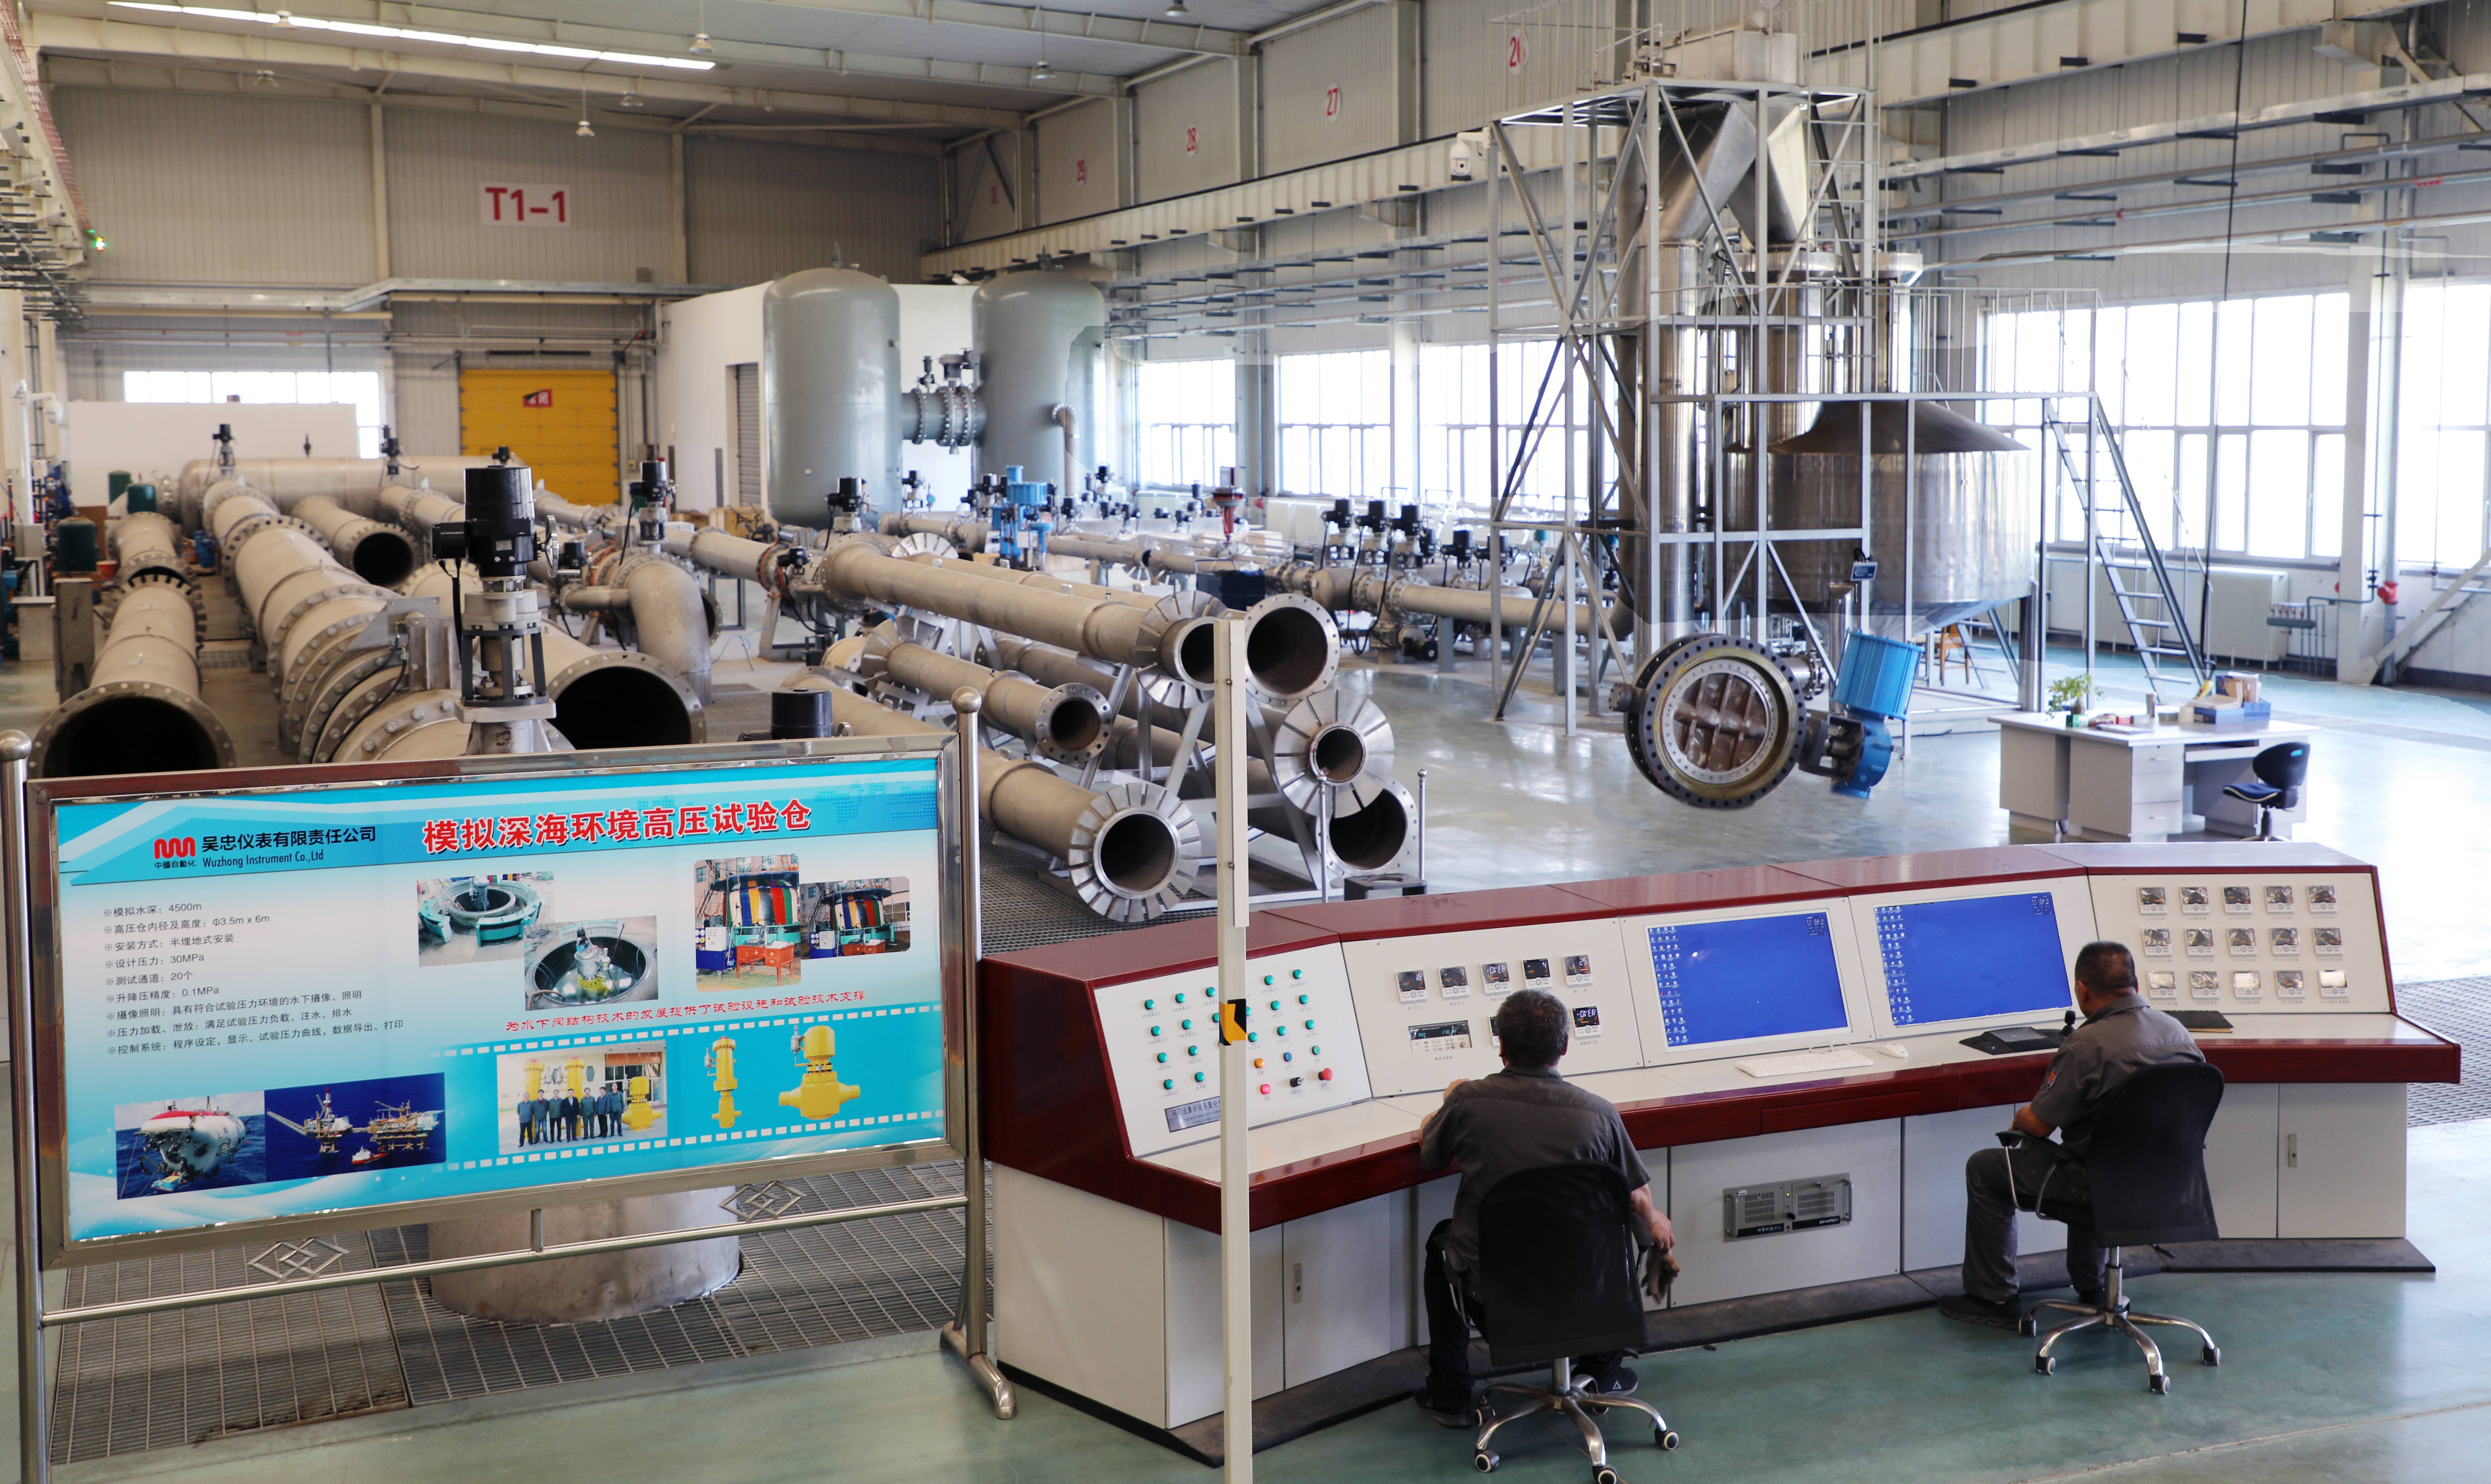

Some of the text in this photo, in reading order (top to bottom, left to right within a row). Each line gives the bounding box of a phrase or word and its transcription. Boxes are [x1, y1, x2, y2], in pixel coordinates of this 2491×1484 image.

[485, 187, 566, 222] T1-1
[202, 826, 376, 852] 吴忠仪表有限责任公司
[422, 798, 811, 854] 模拟深海环境高压试验仓
[154, 861, 196, 869] 中國自動化
[203, 849, 324, 868] Wuzhong Instrument Co.,Ltd
[505, 990, 866, 1032] 为水下阀结构技术的发展提供了试验设施和试验技术支撑
